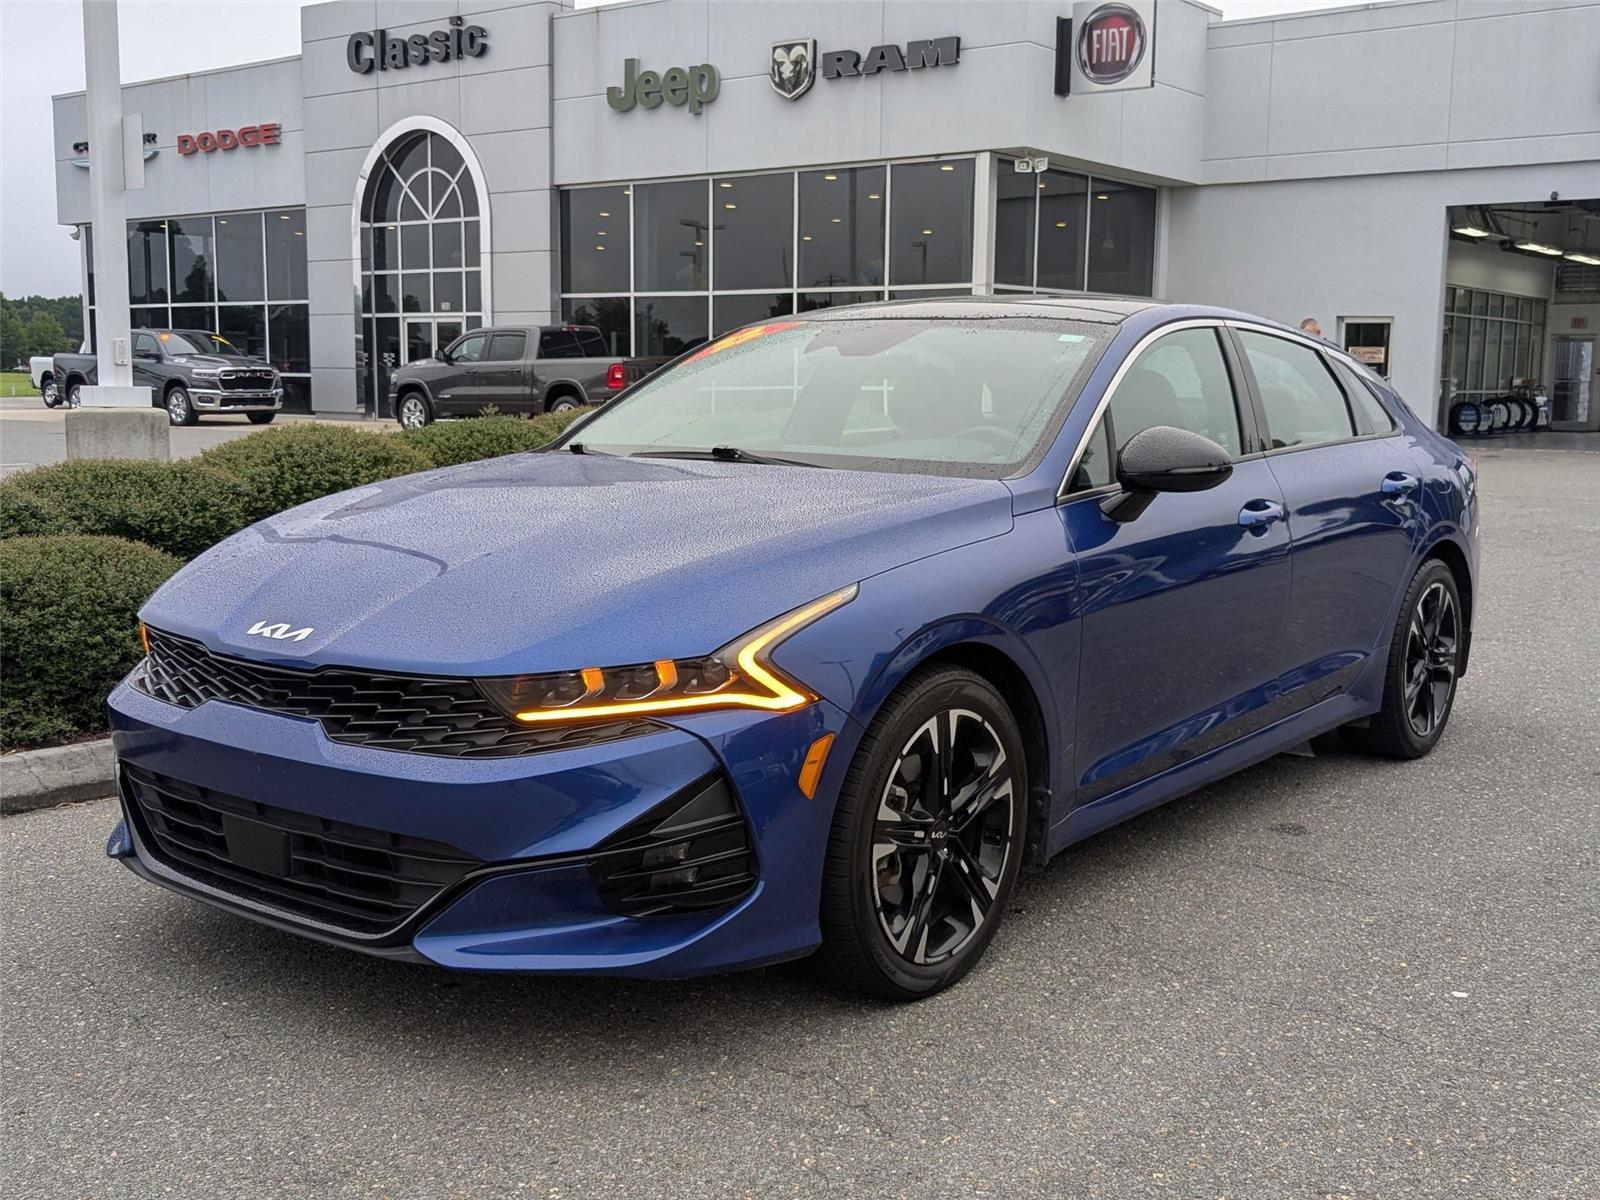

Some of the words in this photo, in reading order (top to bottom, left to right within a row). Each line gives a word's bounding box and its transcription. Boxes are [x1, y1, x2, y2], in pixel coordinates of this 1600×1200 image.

[346, 15, 488, 74] Classic
[822, 36, 961, 80] RAM
[1091, 26, 1131, 65] FIAT
[606, 58, 720, 115] Jeep
[177, 123, 281, 155] DODGE
